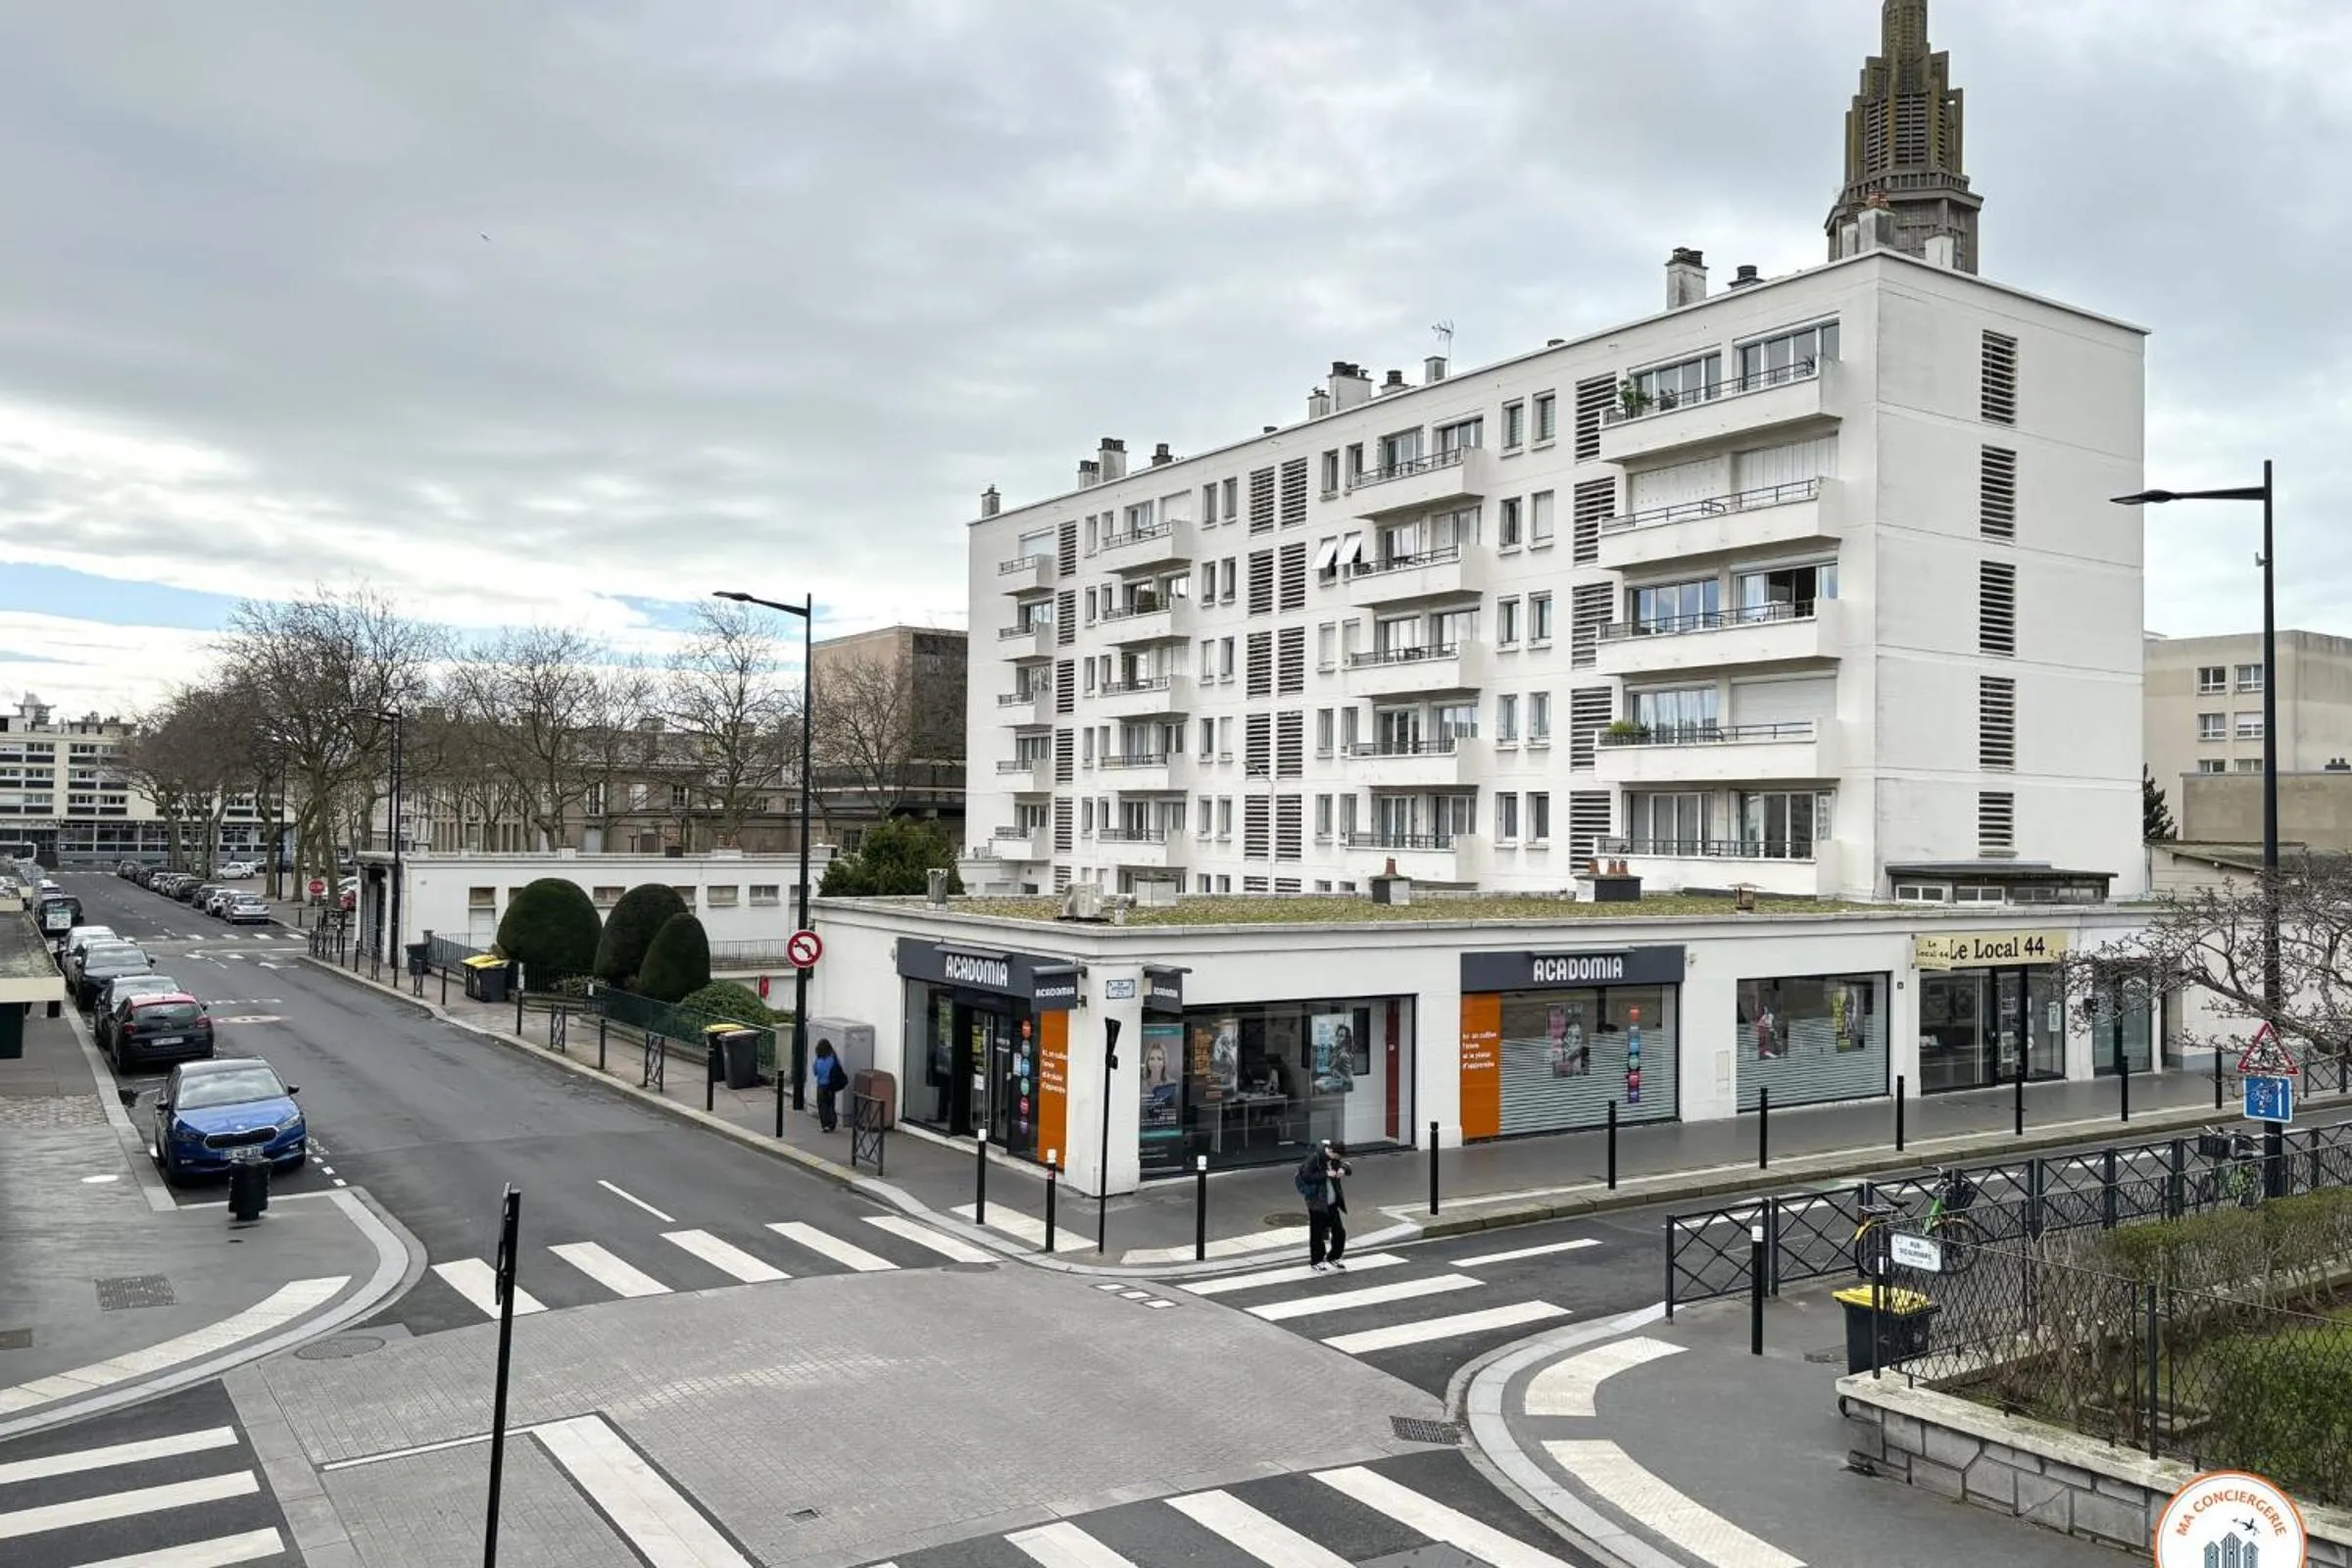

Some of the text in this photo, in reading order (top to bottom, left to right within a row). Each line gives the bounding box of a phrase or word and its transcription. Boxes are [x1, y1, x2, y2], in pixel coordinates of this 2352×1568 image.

[1950, 938, 1968, 959] Le
[1974, 937, 2019, 959] Local
[2024, 936, 2045, 956] 44
[945, 954, 1007, 987] ACADOMIA
[1533, 956, 1623, 981] ACADOMIA
